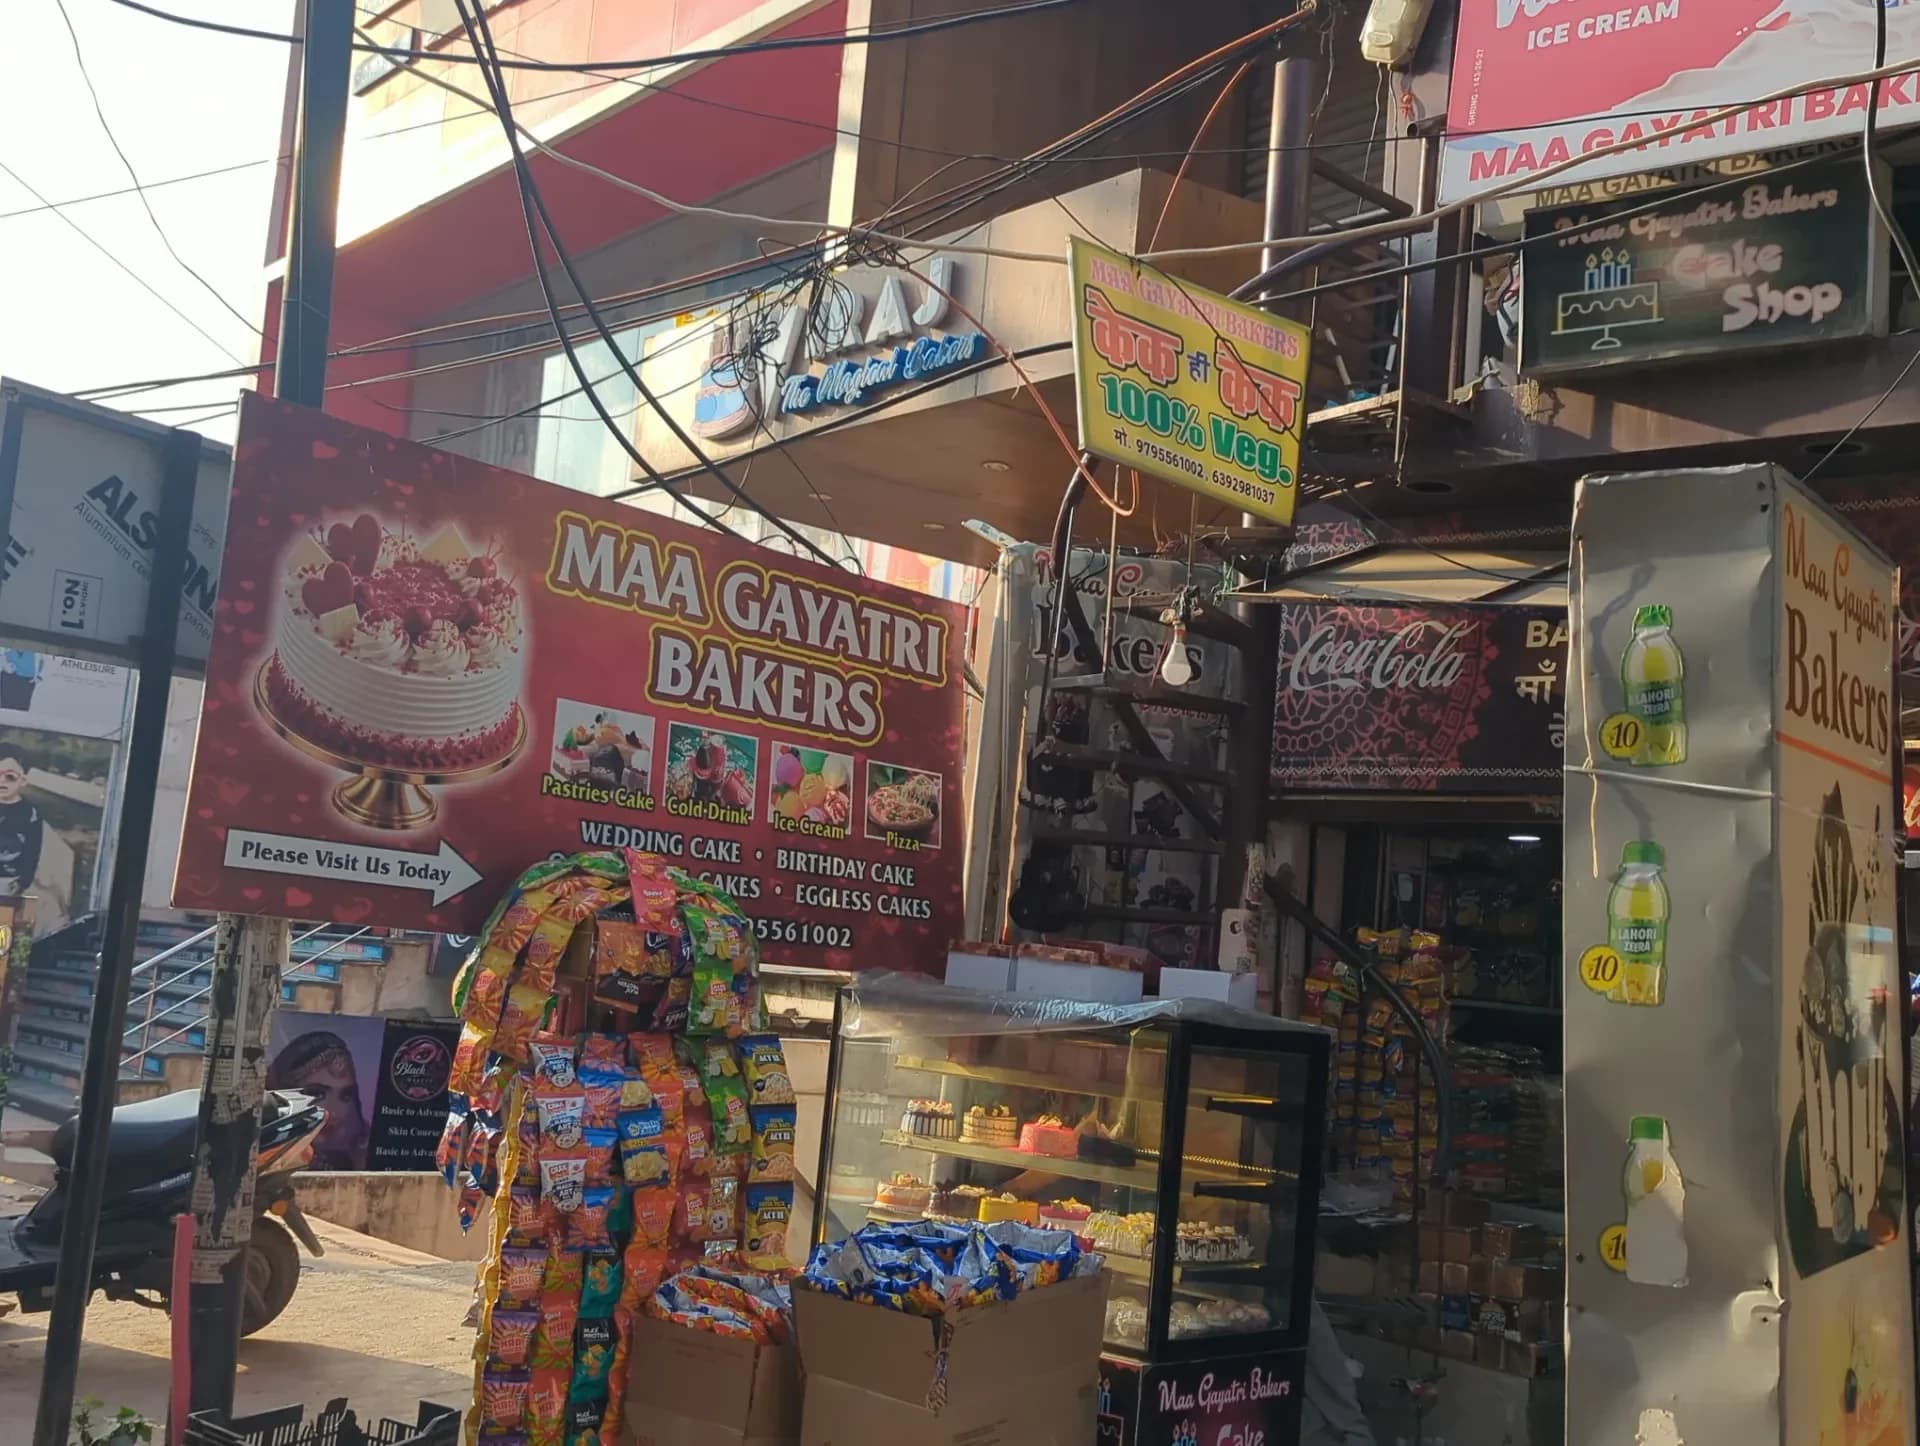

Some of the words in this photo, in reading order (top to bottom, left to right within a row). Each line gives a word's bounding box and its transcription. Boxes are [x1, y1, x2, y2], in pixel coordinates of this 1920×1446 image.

[1527, 22, 1570, 50] ICE
[1577, 0, 1680, 40] CREAM
[1469, 136, 1570, 182] MAA
[1581, 95, 1794, 158] GAYATRI
[1803, 70, 1920, 122] BAK
[1535, 181, 1594, 208] MAA
[1555, 215, 1624, 248] Maa
[1629, 200, 1734, 241] Gayatri
[1743, 185, 1838, 220] Bakers
[1669, 239, 1783, 289] Cake
[1722, 282, 1843, 333] Shop
[1085, 284, 1184, 385] केक
[1214, 336, 1302, 433] केक
[1225, 310, 1299, 360] BAKERS
[780, 374, 812, 414] The
[815, 347, 898, 404] Magical
[1097, 372, 1207, 452] 100%
[1209, 412, 1295, 487] Veg.
[1212, 470, 1275, 506] 6392981037
[74, 501, 131, 561] Aluminium
[1784, 502, 1829, 600] Maa
[1832, 543, 1888, 643] Gayatri
[553, 520, 706, 620] MAA
[721, 570, 948, 679] GAYATRI
[61, 658, 117, 676] ATHLEISURE
[653, 634, 880, 741] BAKERS
[1784, 602, 1889, 756] Bakers
[543, 775, 610, 804] Pastries
[614, 787, 655, 811] Cake
[240, 839, 309, 866] Please
[315, 849, 359, 873] Visit
[365, 855, 391, 877] Us
[396, 860, 452, 887] Today
[580, 820, 684, 858] WEDDING
[689, 836, 742, 864] CAKE
[886, 831, 921, 852] Pizza
[699, 871, 761, 899] CAKES
[776, 848, 868, 882] BIRTHDAY
[870, 862, 915, 888] CAKE
[795, 884, 872, 912] EGGLESS
[876, 892, 932, 920] CAKES
[1617, 927, 1657, 941] LAHORI
[1623, 939, 1651, 953] ZEERA
[381, 1105, 405, 1117] Basic
[406, 1106, 416, 1117] to
[388, 1126, 408, 1138] Skin
[1608, 1233, 1626, 1261] 1
[1158, 1380, 1195, 1413] Maa
[1197, 1372, 1247, 1414] Gayatri
[1249, 1366, 1291, 1400] Bakers
